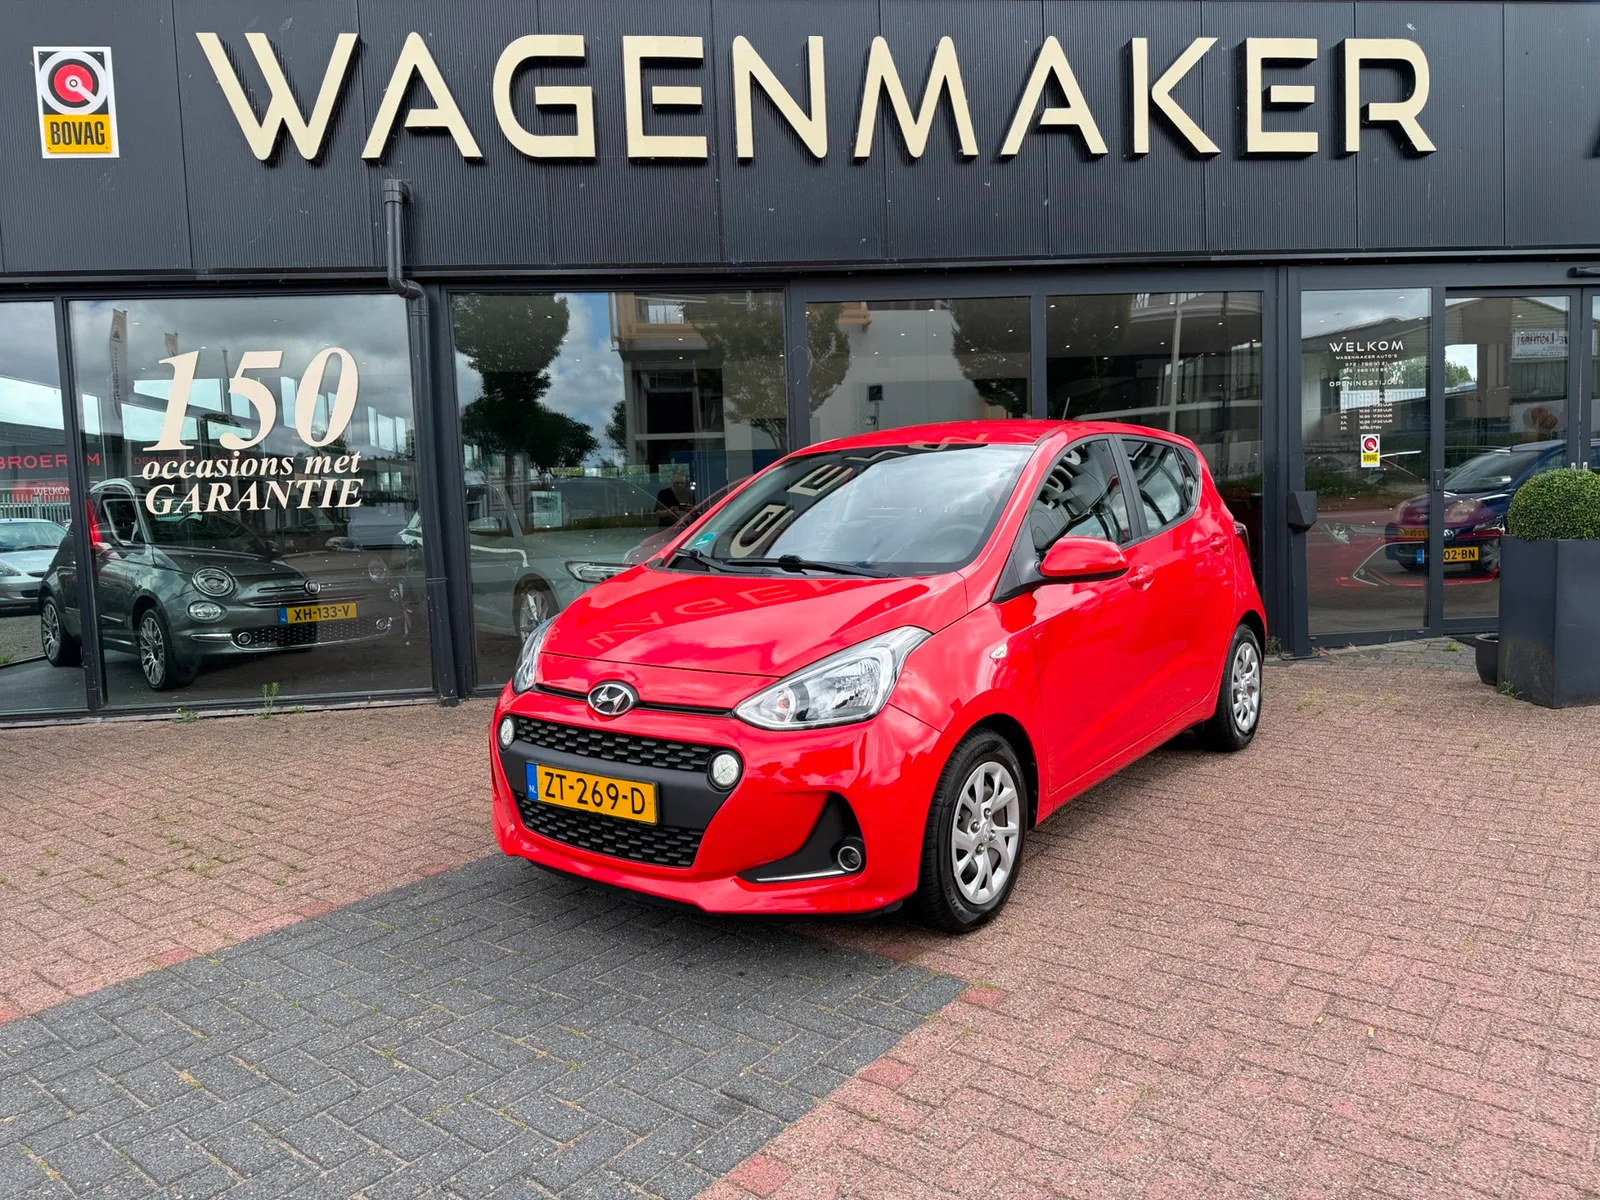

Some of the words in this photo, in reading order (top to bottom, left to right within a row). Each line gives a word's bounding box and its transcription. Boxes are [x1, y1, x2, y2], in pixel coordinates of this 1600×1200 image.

[198, 32, 1436, 160] WAGENMAKER
[50, 121, 106, 146] BOVAG
[1329, 340, 1404, 352] WELKOM
[143, 347, 359, 451] 150
[142, 450, 294, 480] occasions
[304, 451, 362, 475] met
[145, 478, 365, 515] GARANTIE
[294, 604, 350, 621] XH-133-V
[544, 771, 645, 815] ZT-269-D
